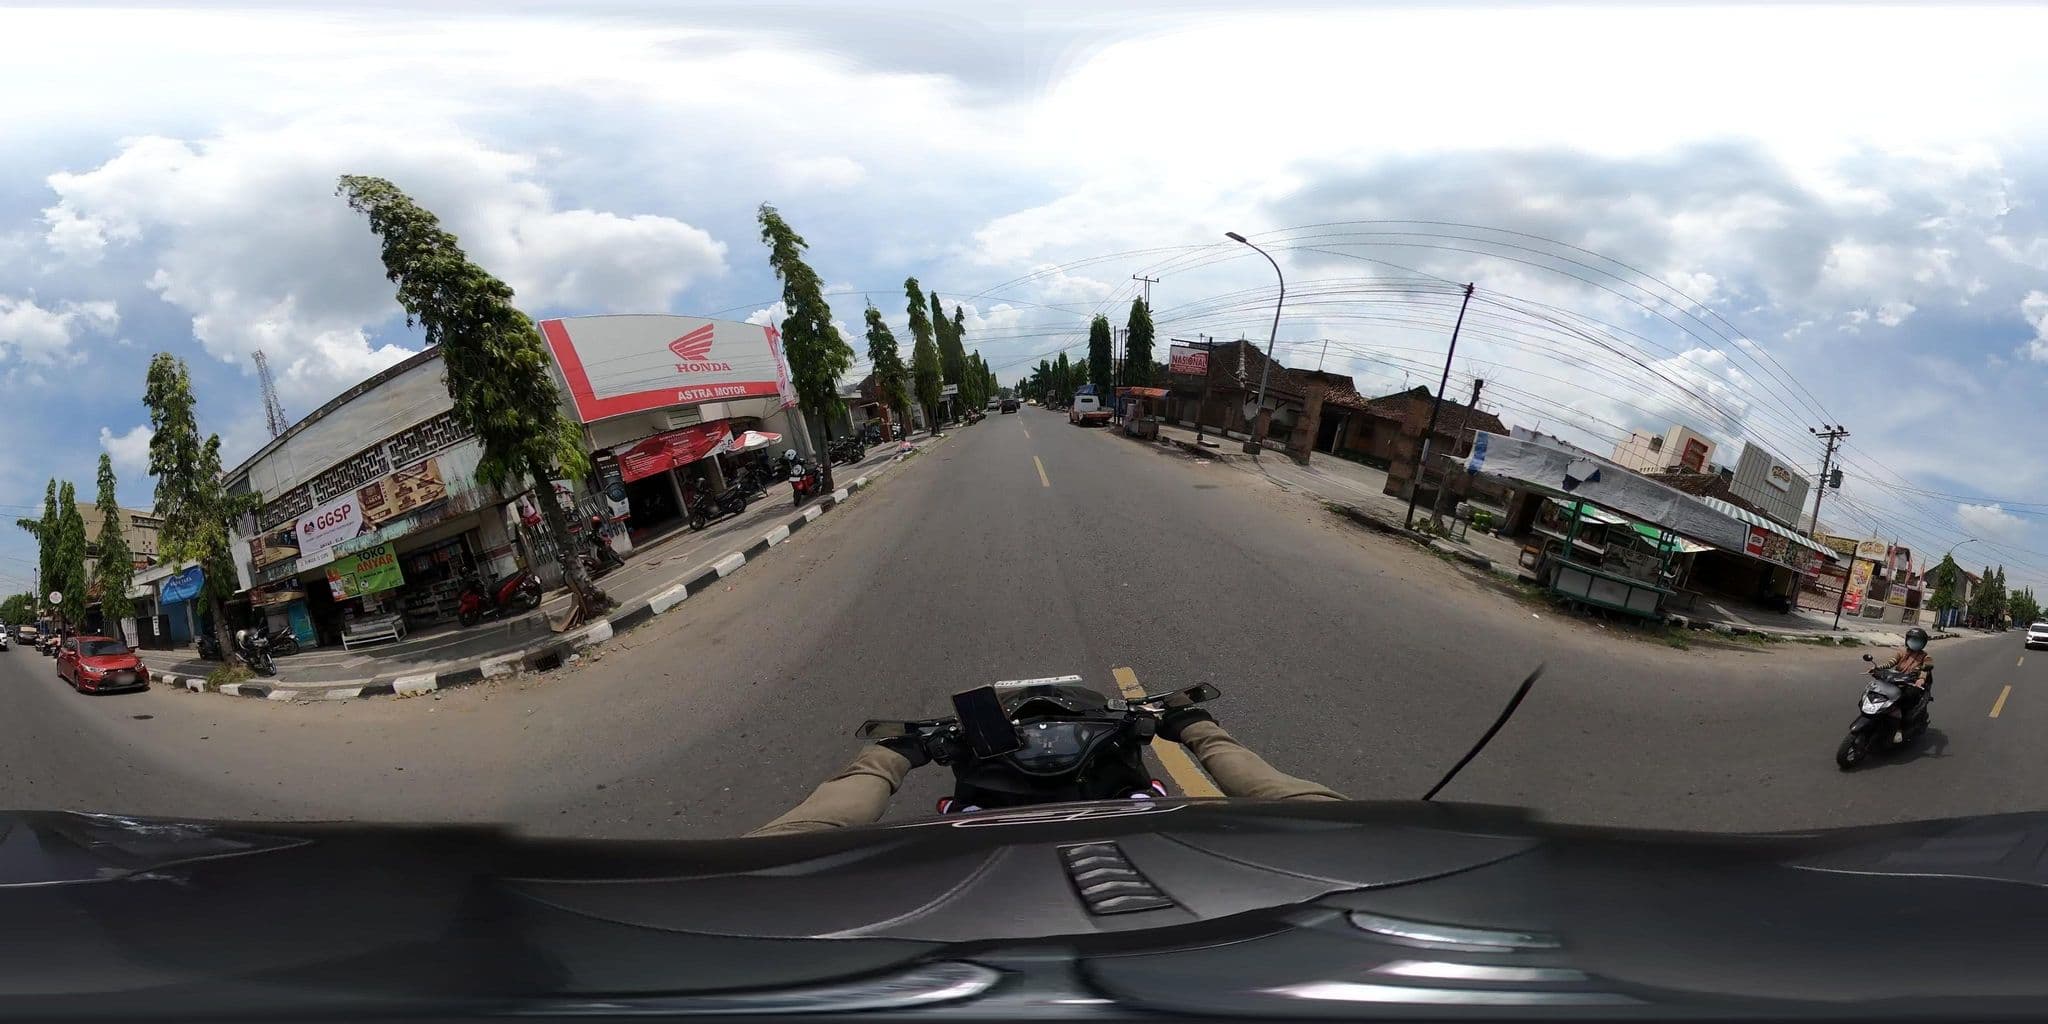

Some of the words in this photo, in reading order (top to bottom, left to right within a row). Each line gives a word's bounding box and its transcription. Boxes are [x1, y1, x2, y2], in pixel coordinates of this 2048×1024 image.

[675, 362, 732, 373] HONDA
[1172, 354, 1207, 367] NASIONAL
[678, 388, 713, 401] ASTRA
[714, 385, 747, 397] MOTOR
[317, 504, 351, 530] GGSP
[357, 546, 386, 562] TOKO
[357, 553, 394, 573] ANYAR
